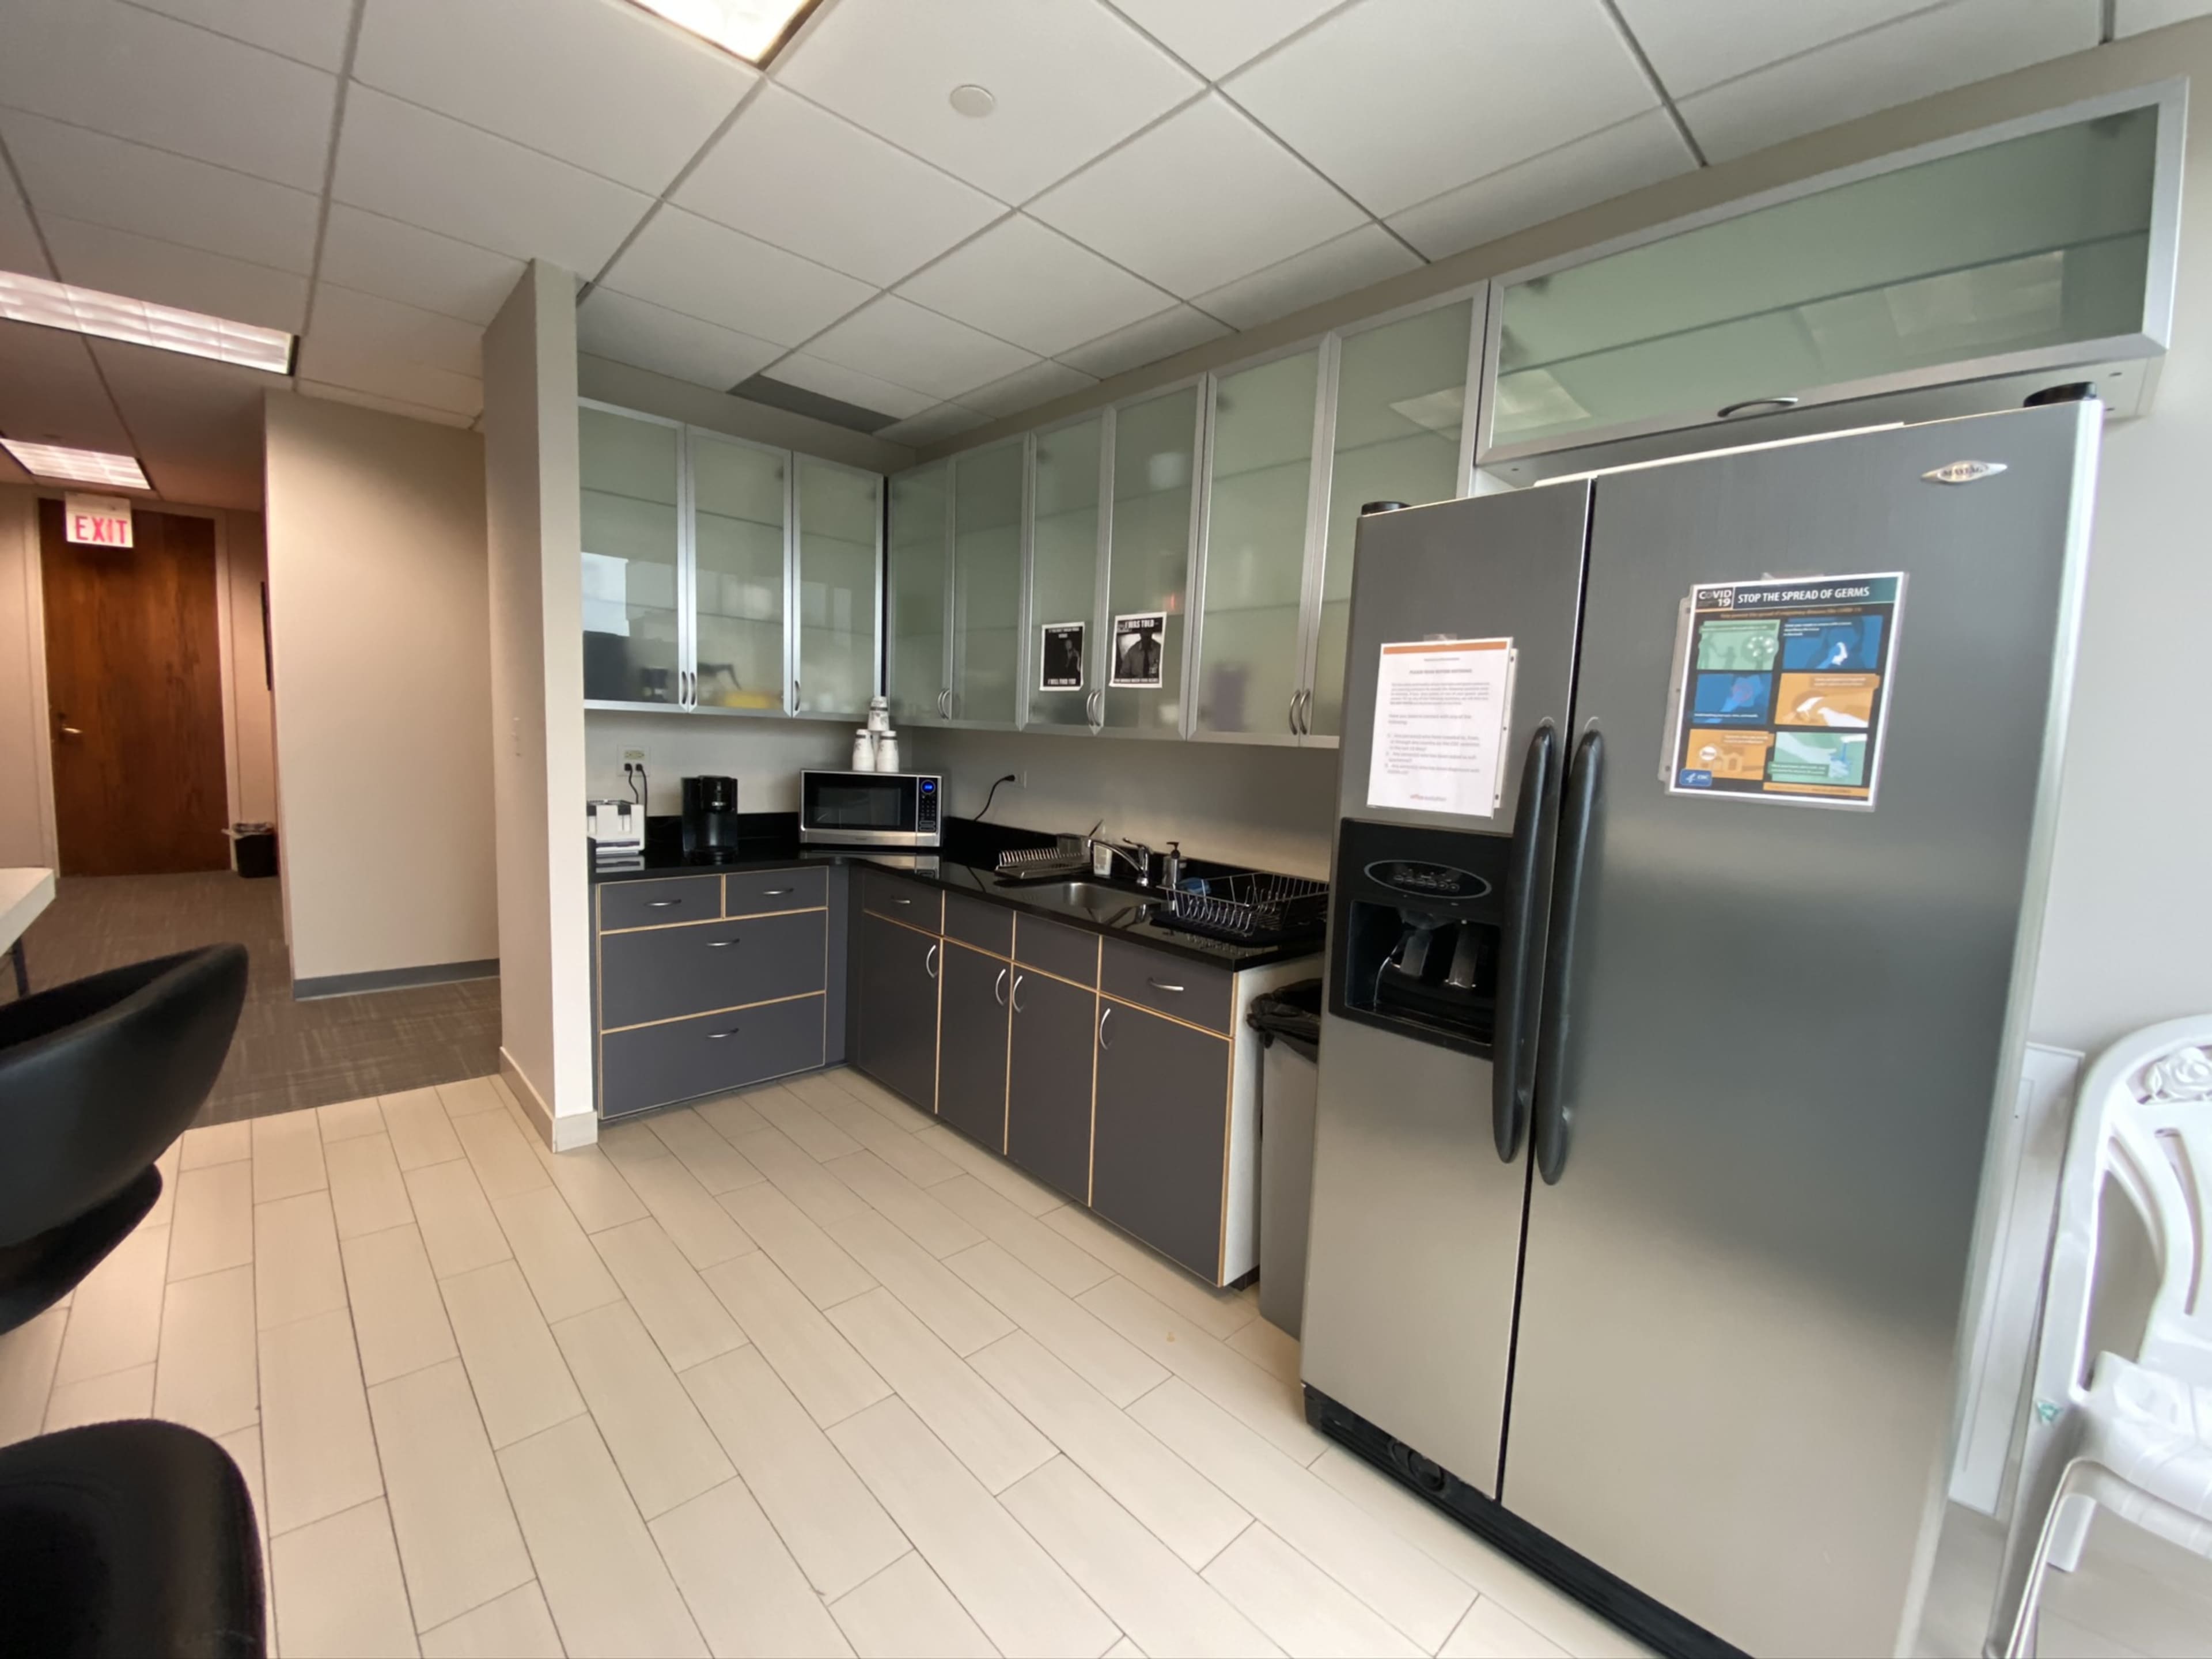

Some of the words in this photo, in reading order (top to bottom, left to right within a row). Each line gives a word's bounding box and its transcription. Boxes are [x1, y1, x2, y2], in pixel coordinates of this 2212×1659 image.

[75, 515, 127, 544] EXIT
[1718, 599, 1731, 607] 19
[1738, 594, 1761, 604] STOP
[1763, 592, 1781, 602] THE
[1781, 590, 1819, 601] SPREAD
[1820, 589, 1834, 599] OF
[1835, 586, 1870, 598] GERMS
